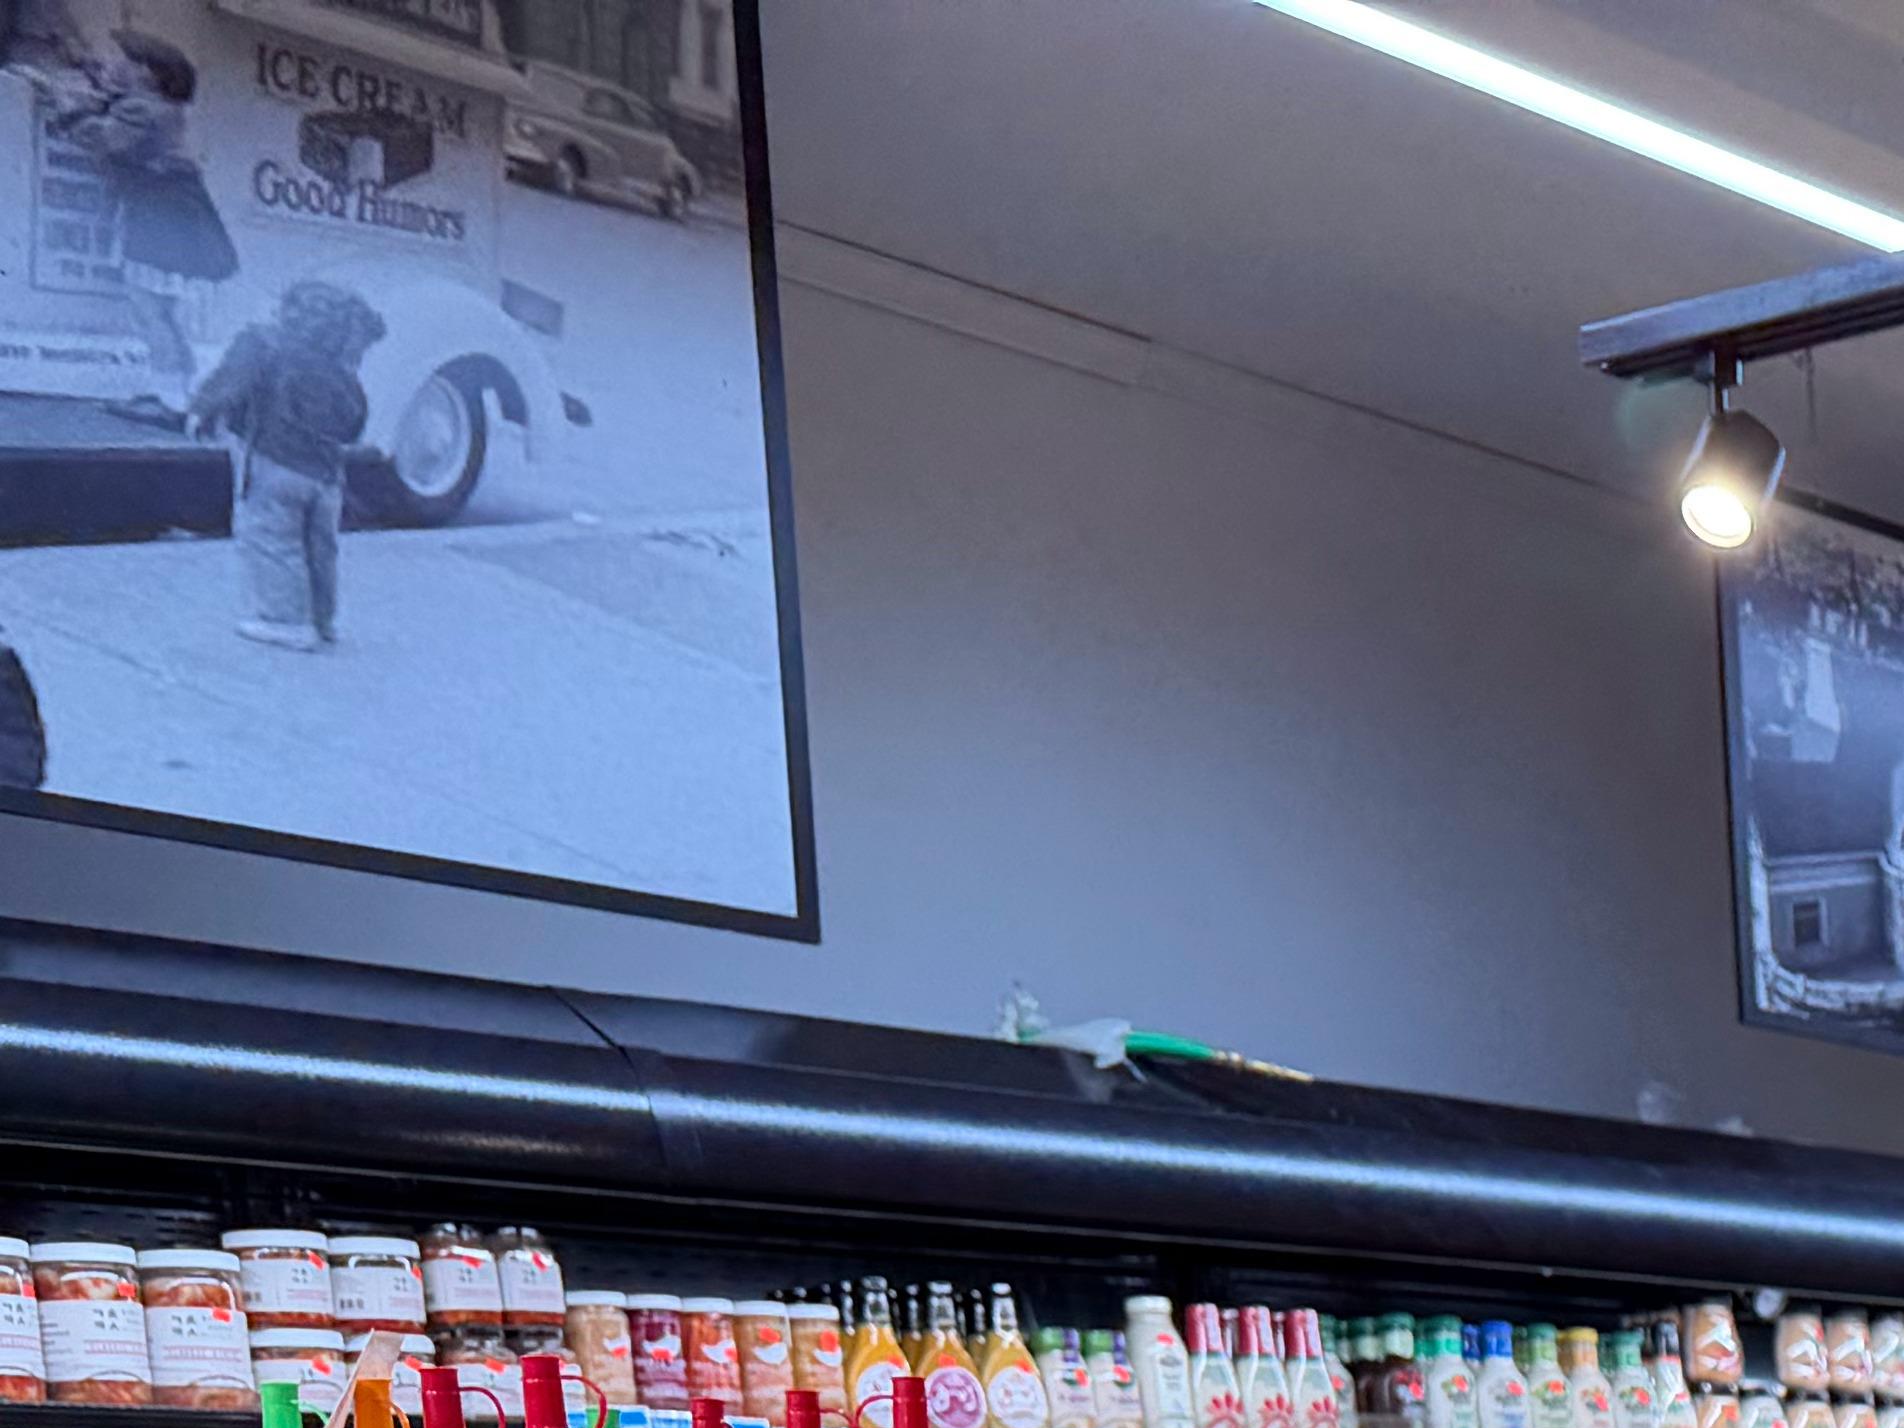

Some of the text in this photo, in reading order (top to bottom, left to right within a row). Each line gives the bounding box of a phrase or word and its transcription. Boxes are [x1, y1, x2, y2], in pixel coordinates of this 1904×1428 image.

[257, 42, 466, 138] ICE CREAM
[254, 159, 347, 219] Good
